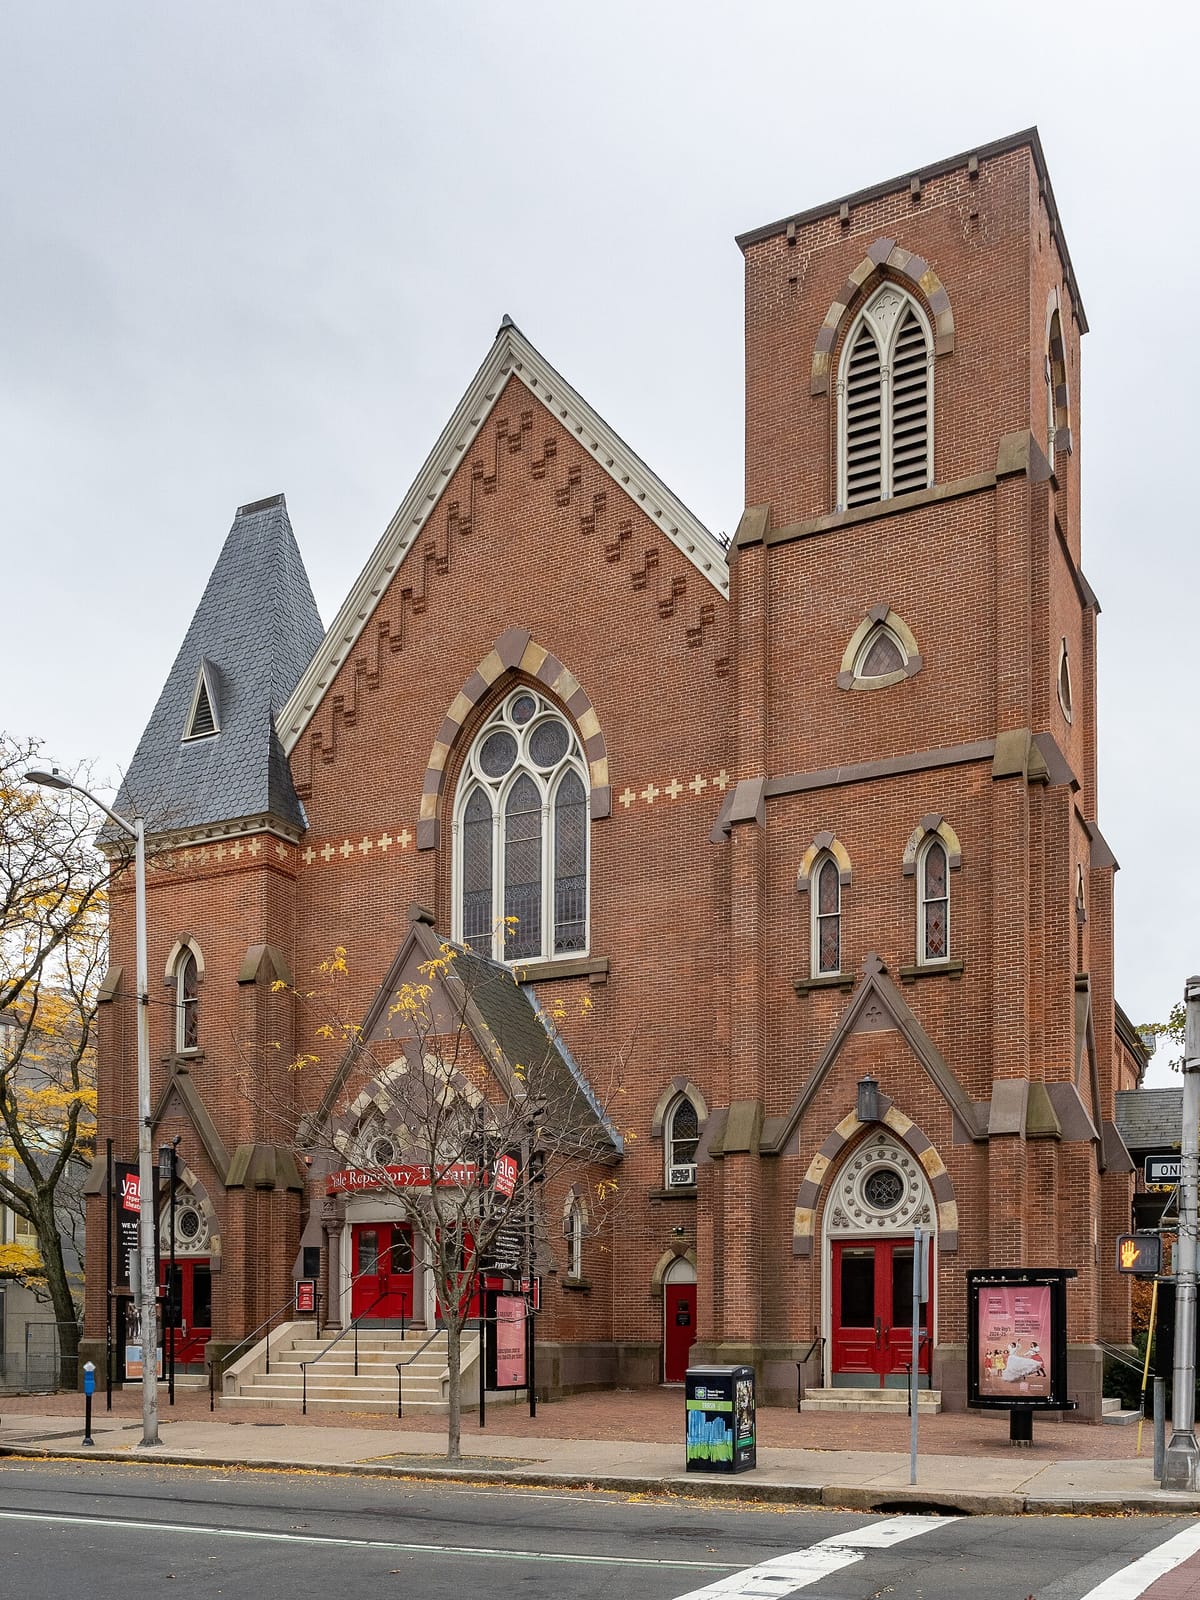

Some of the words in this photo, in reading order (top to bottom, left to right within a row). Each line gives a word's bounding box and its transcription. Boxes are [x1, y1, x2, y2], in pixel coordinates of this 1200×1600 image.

[492, 1158, 514, 1180] yale
[1160, 1165, 1181, 1176] ON
[120, 1179, 141, 1197] yal
